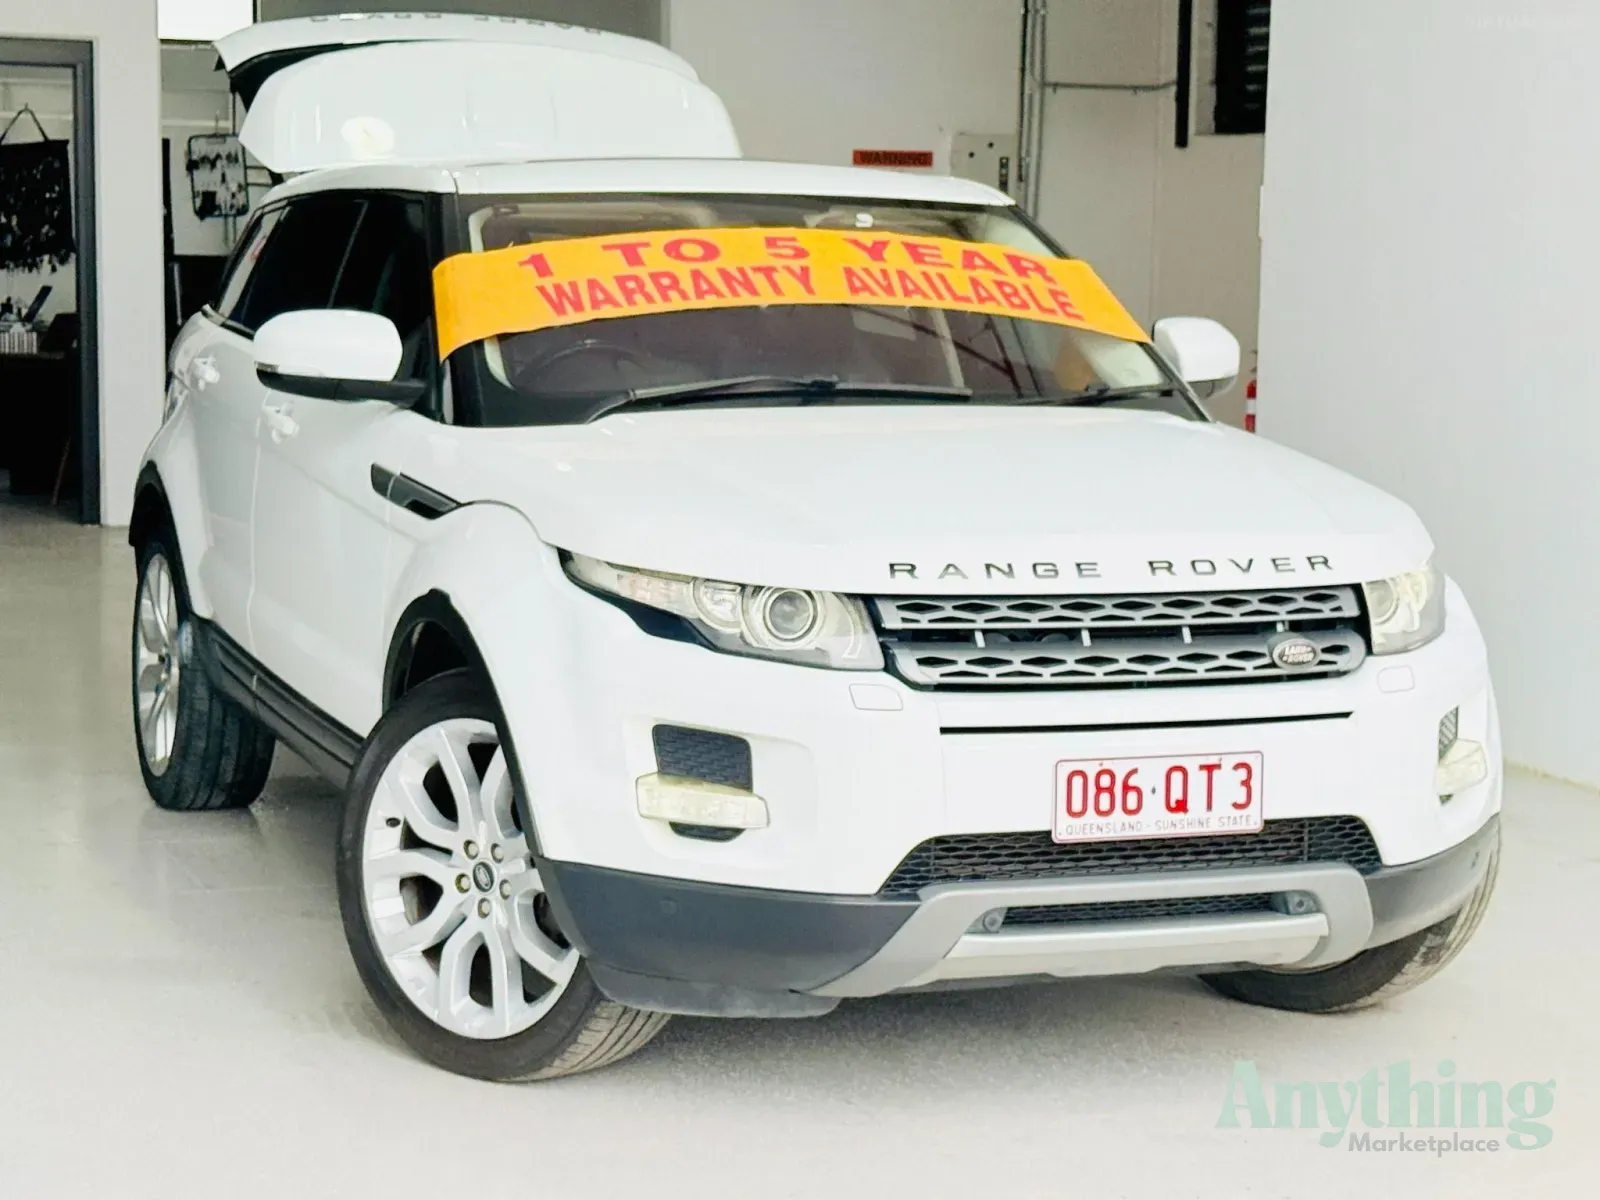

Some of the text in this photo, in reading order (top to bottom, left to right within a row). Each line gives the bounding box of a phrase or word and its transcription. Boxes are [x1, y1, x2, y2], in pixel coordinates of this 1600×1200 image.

[518, 236, 1058, 286] 1 TO 5 YEAR
[535, 265, 1085, 322] WARRANTY AVAILABLE
[889, 554, 1334, 580] RANGE ROVER
[1066, 762, 1253, 818] 086 QT3
[1065, 822, 1143, 836] QUEENSLAND
[1154, 816, 1212, 831] SUNSHINE
[1217, 814, 1251, 828] STATE
